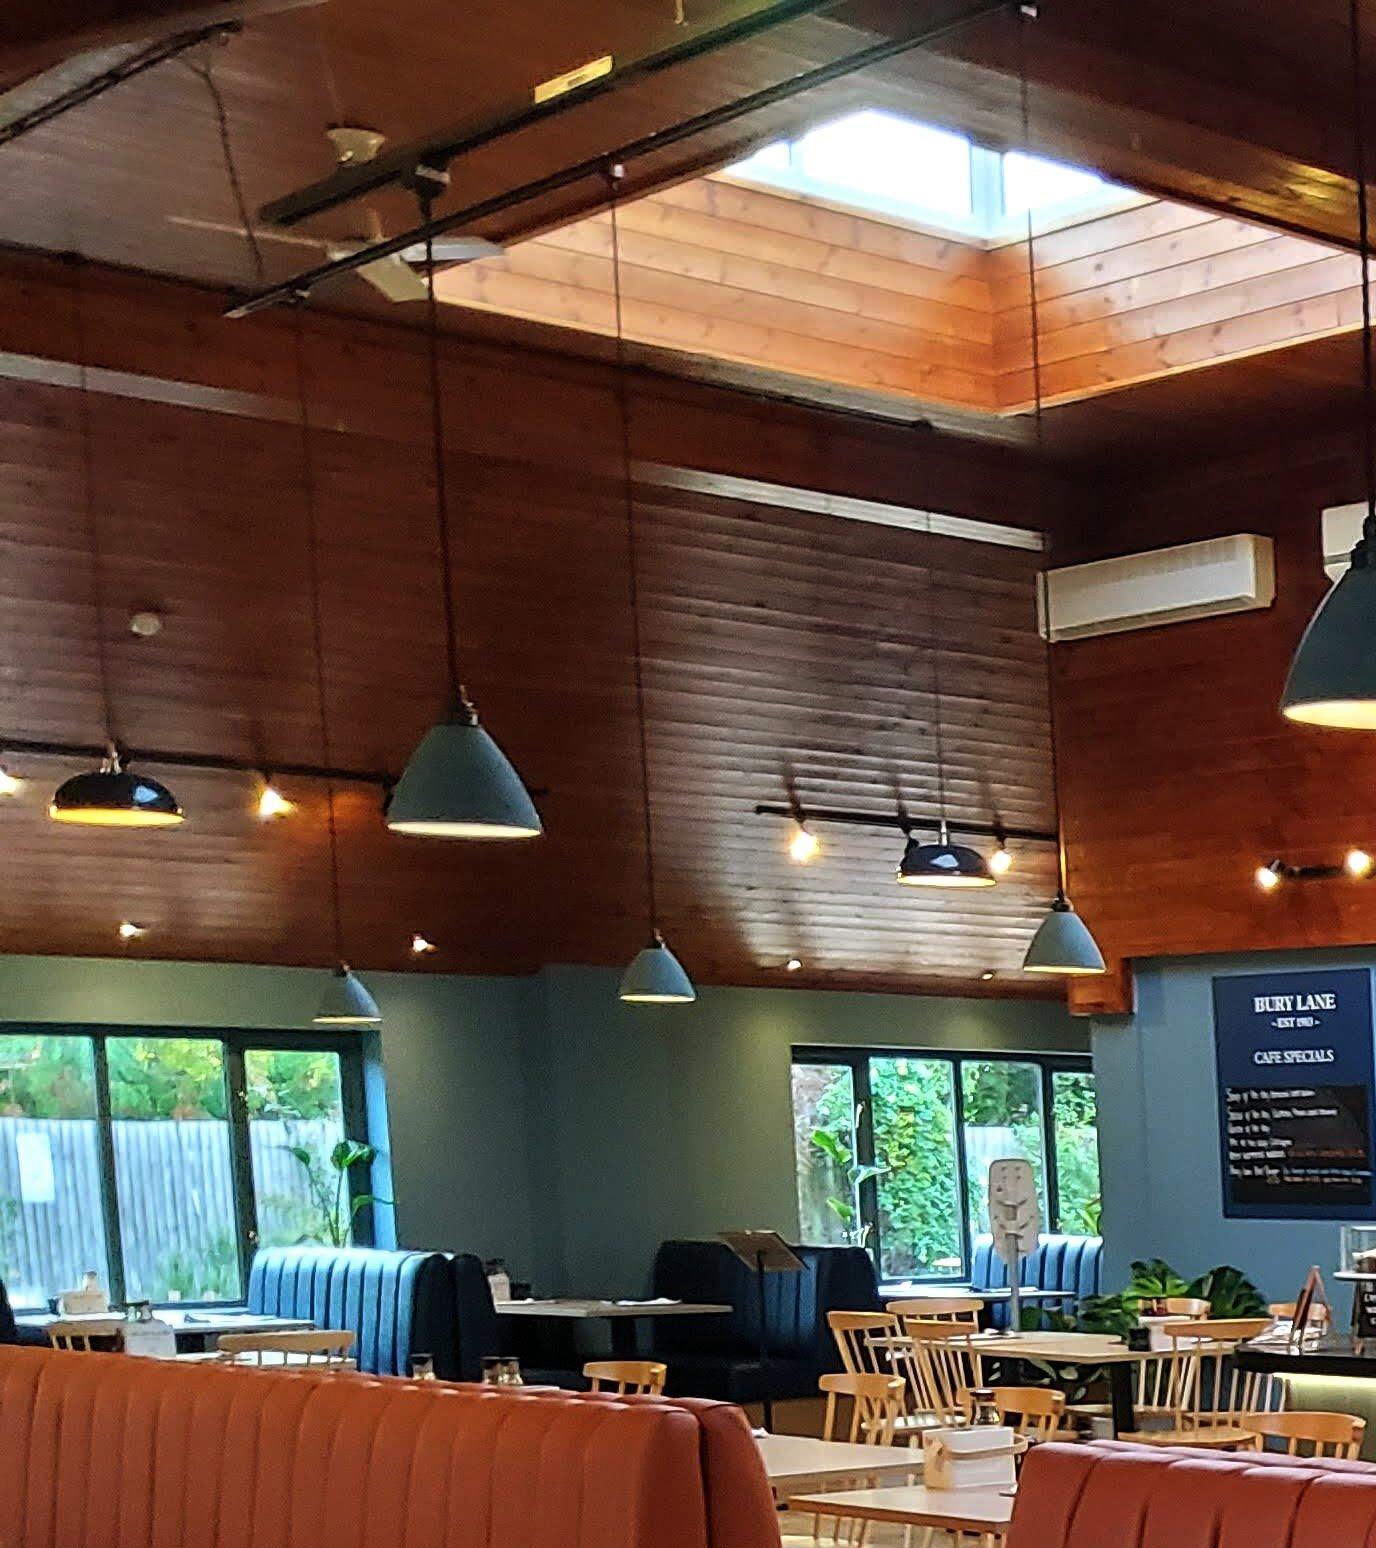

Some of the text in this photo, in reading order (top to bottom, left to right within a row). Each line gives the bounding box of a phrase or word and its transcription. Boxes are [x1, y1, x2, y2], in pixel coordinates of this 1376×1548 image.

[1254, 993, 1337, 1013] BURY LANE
[1254, 1049, 1335, 1065] CAFE SPECIALS
